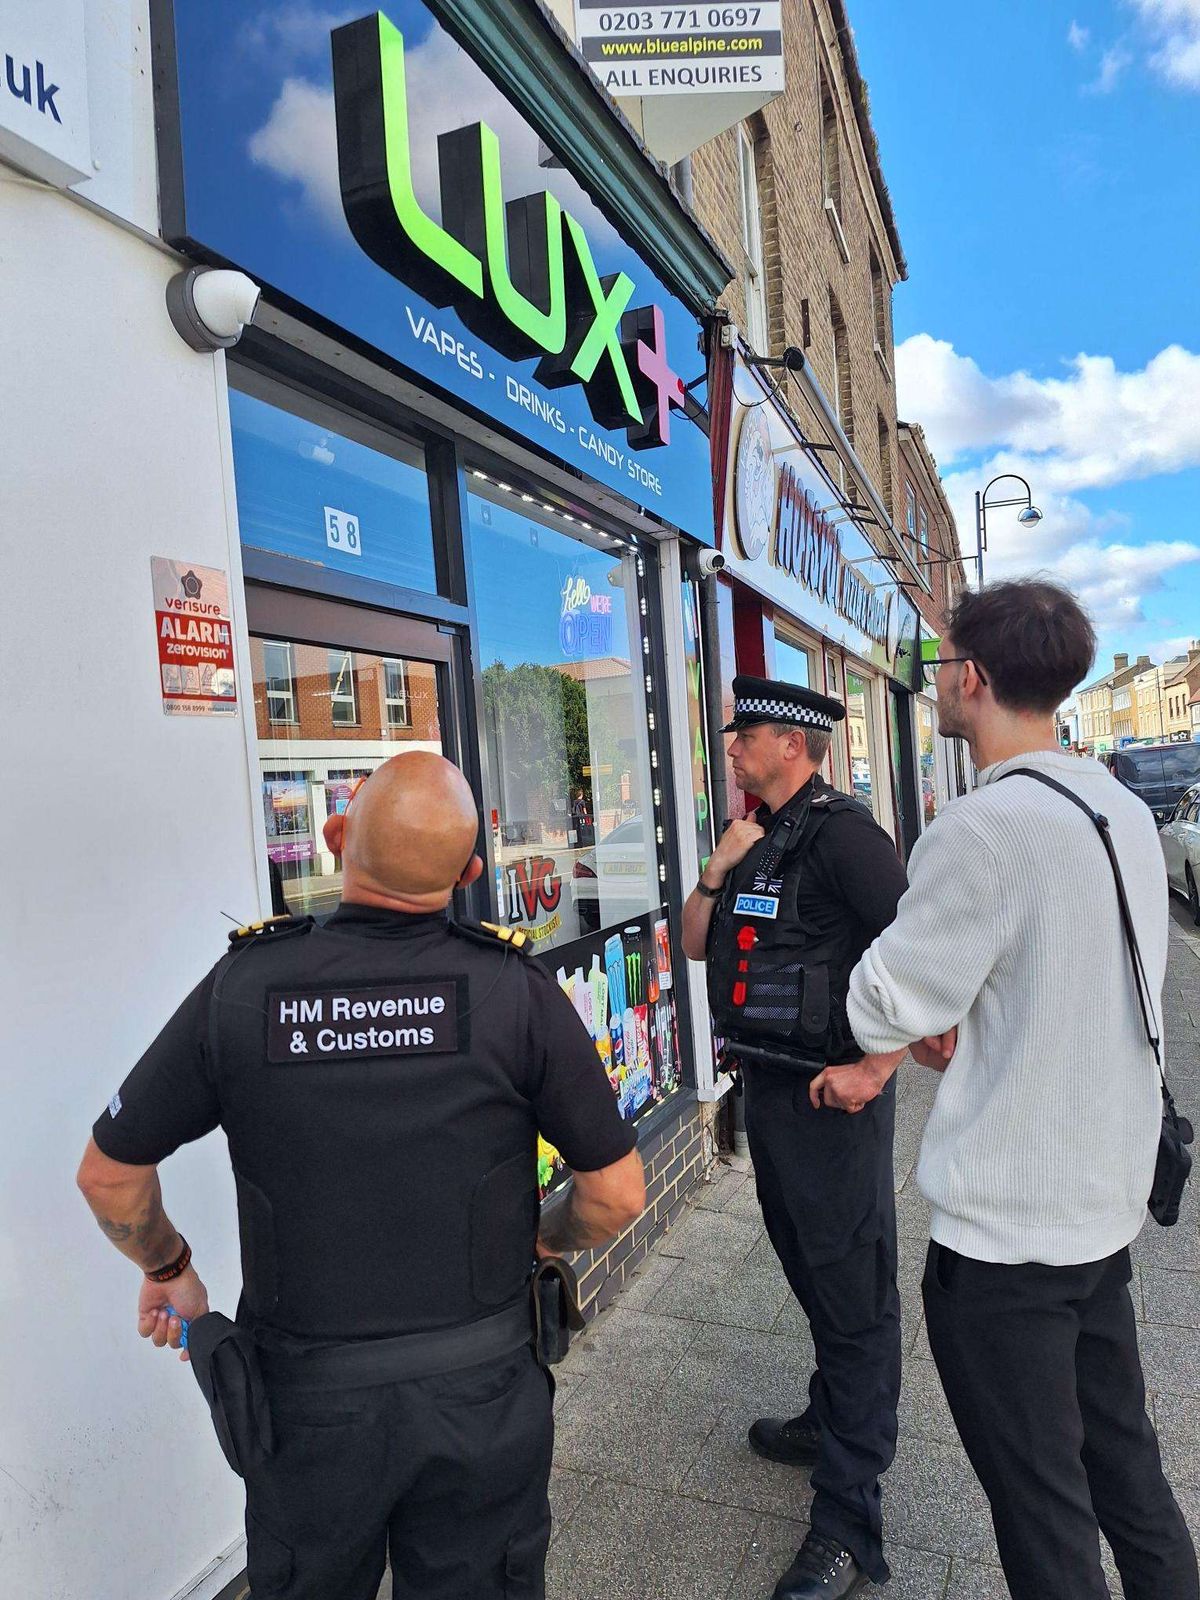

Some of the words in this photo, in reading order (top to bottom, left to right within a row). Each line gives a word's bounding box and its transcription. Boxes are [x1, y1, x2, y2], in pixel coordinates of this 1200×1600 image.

[600, 12, 653, 31] 0203
[661, 10, 700, 29] 771
[708, 8, 761, 27] 0697
[602, 37, 763, 56] www.bluealpine.com
[606, 70, 642, 87] ALL
[649, 66, 762, 86] ENQUIRIES
[405, 305, 483, 379] VAPES
[506, 376, 566, 434] DRINKS
[578, 426, 624, 470] CANDY
[627, 458, 662, 496] STORE
[165, 596, 221, 616] verisure
[160, 616, 230, 645] ALARM
[560, 611, 613, 656] OPEN
[506, 856, 562, 924] IVG
[738, 899, 773, 912] POLICE
[279, 999, 323, 1024] HM
[332, 996, 446, 1021] Revenue
[289, 1031, 309, 1054] &
[316, 1026, 435, 1052] Customs
